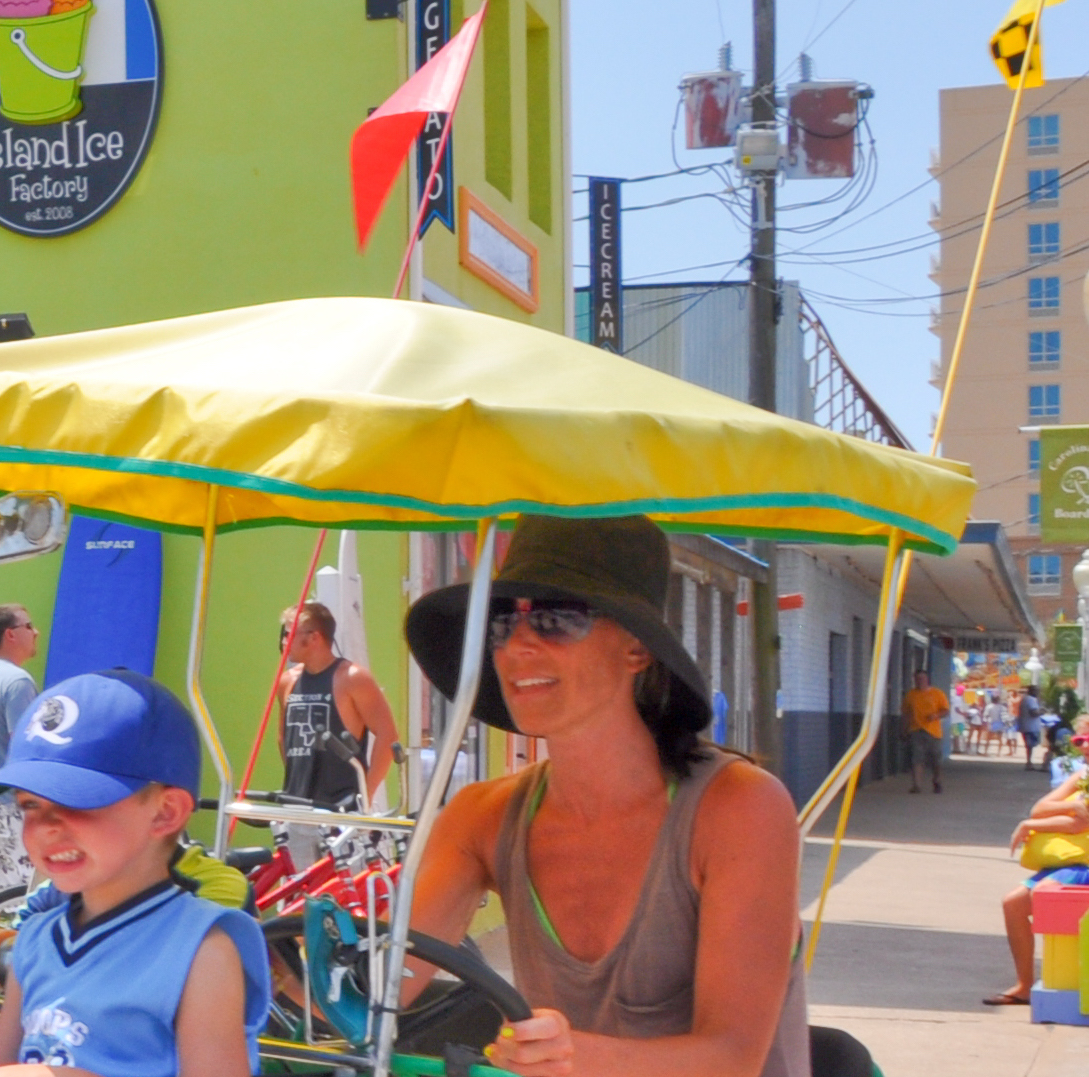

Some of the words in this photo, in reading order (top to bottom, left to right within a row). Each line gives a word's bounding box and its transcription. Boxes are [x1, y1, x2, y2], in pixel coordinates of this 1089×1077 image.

[423, 2, 444, 201] GEATO
[74, 119, 124, 169] Ice
[9, 173, 88, 203] Factory
